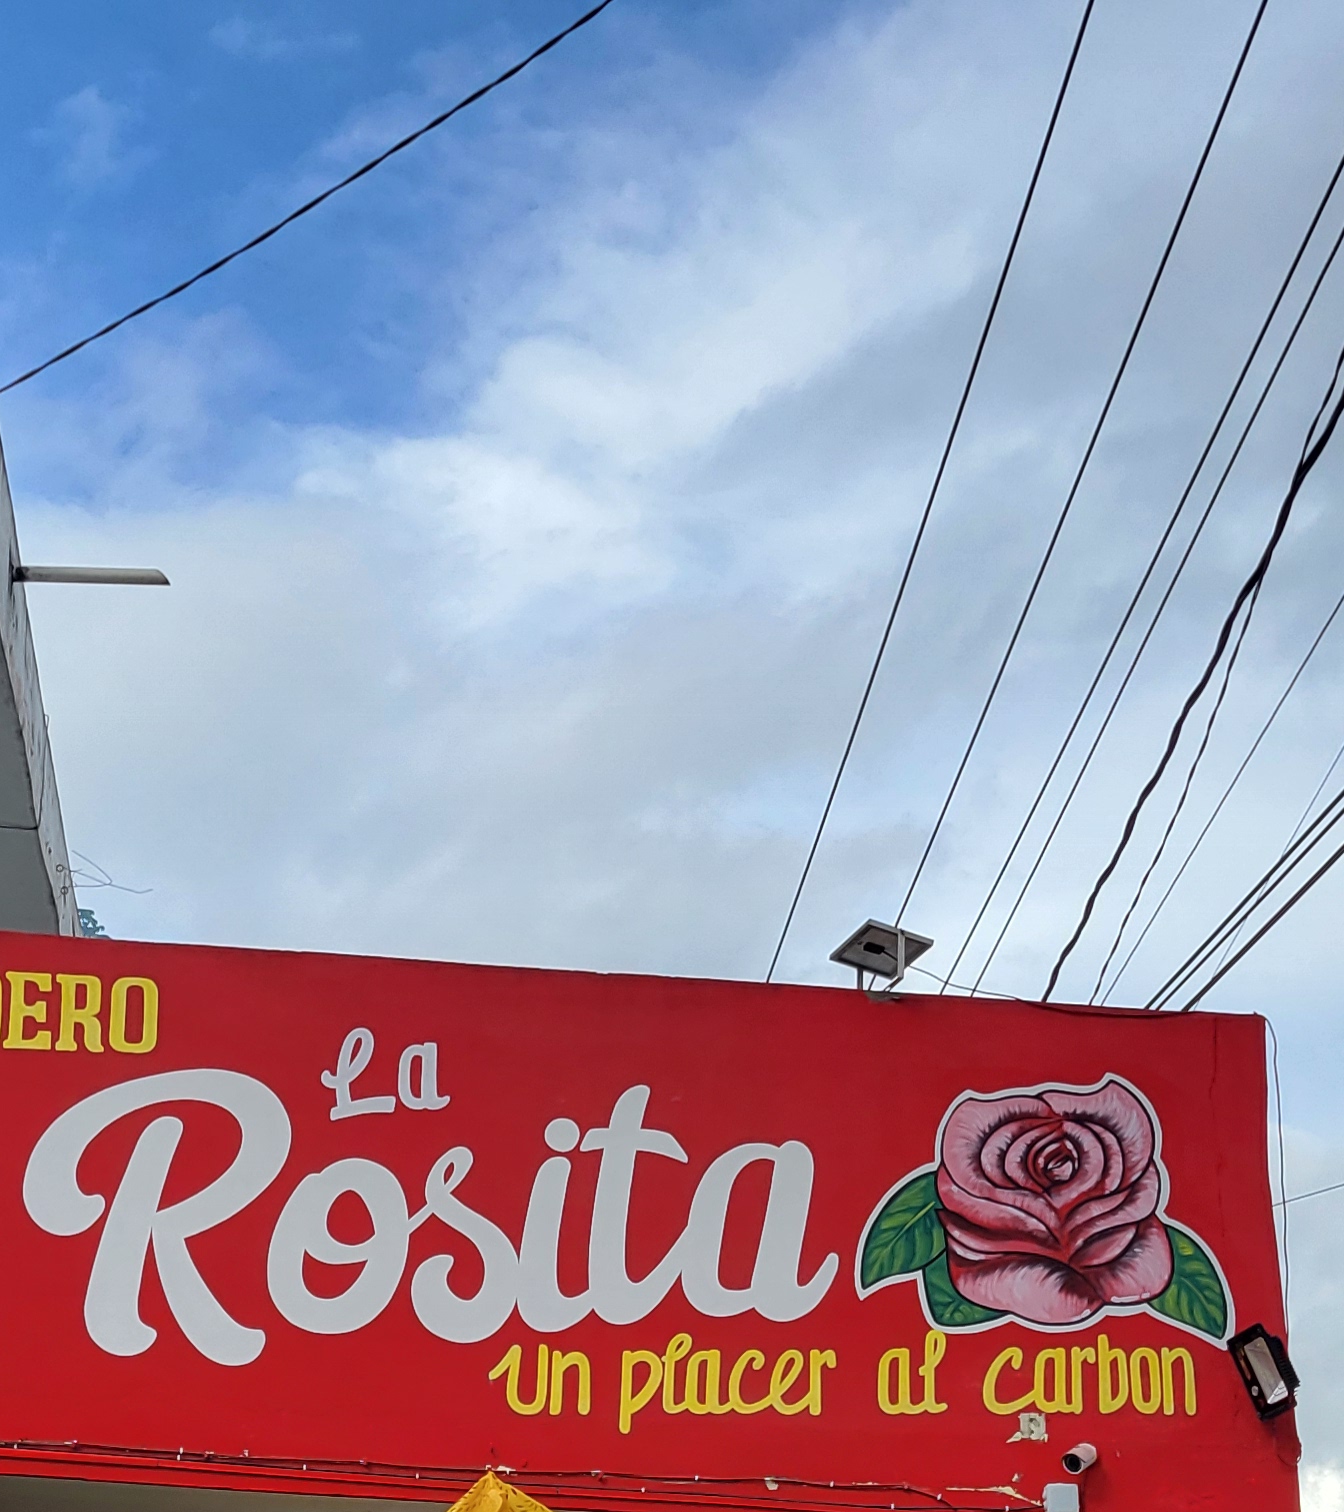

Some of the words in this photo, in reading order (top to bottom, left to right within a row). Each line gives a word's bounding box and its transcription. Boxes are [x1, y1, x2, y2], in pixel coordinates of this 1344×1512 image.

[321, 1026, 451, 1121] La
[22, 1068, 840, 1366] Rosita
[619, 1331, 837, 1434] placer
[877, 1328, 949, 1414] al
[982, 1333, 1197, 1417] carbon
